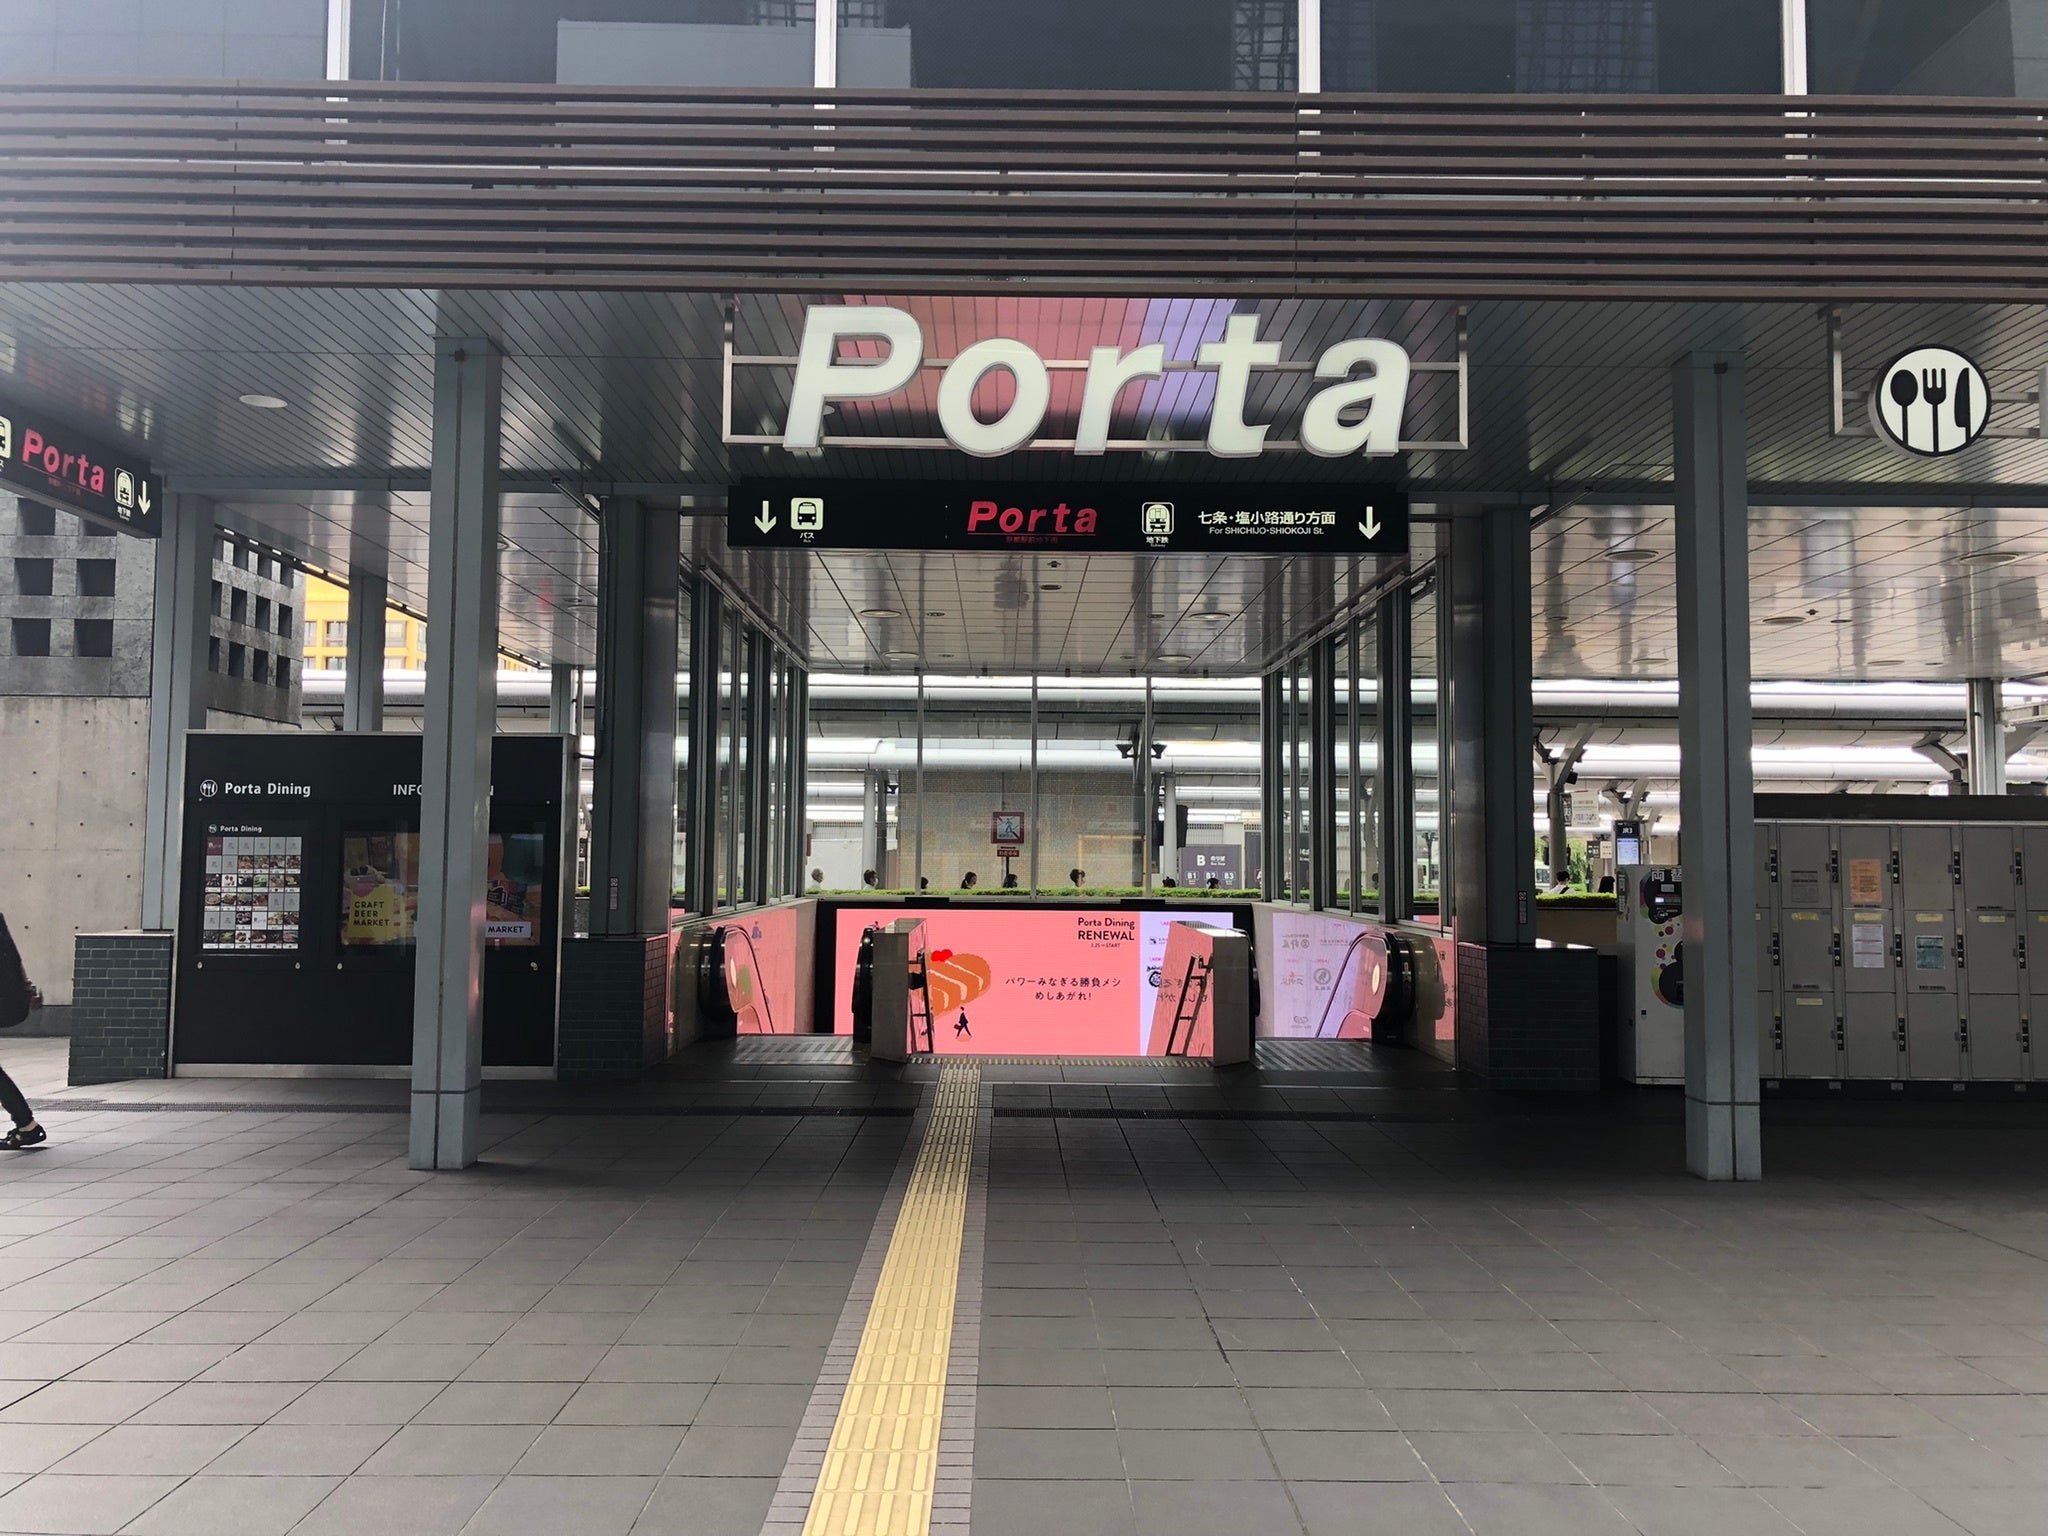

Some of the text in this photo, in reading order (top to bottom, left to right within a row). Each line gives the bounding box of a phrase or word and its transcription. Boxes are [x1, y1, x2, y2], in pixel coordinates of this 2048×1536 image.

[783, 304, 1411, 457] Porta
[22, 428, 105, 493] Porta
[967, 501, 1098, 533] Porta
[1197, 511, 1336, 525] 七条・塩小路通り方面
[1146, 536, 1169, 544] 地下鉄
[224, 783, 311, 797] Porta Dining
[241, 825, 263, 833] Dining
[1197, 854, 1206, 866] B
[353, 919, 390, 927] MARKET
[1078, 917, 1135, 930] Porta Dining
[487, 926, 524, 934] MARKET
[1078, 931, 1135, 940] RENEWAL
[1005, 977, 1121, 987] パワーみなぎる勝負メシ
